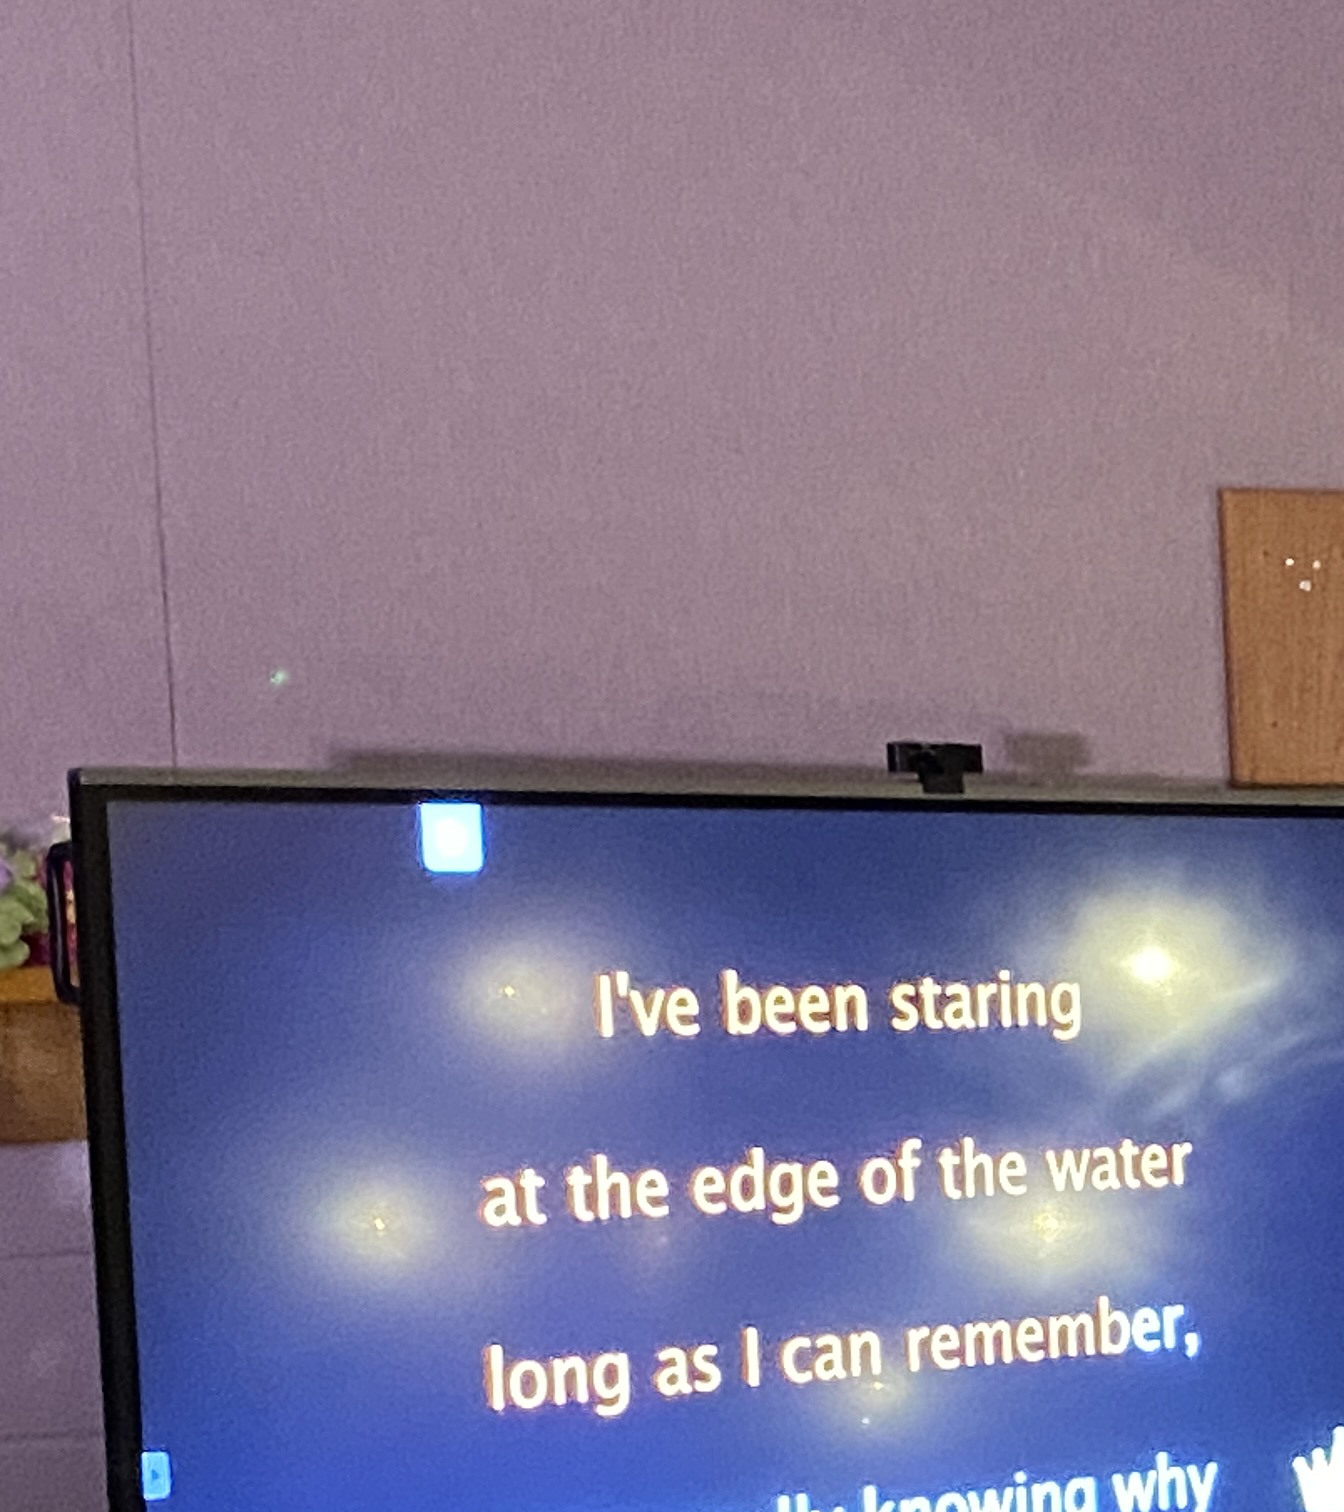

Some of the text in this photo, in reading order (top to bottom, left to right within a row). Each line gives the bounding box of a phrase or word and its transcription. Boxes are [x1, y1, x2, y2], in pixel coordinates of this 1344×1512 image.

[595, 968, 1083, 1039] I've been staring
[482, 1136, 1194, 1228] at the edge of the water
[488, 1294, 1200, 1418] long as I can remember,
